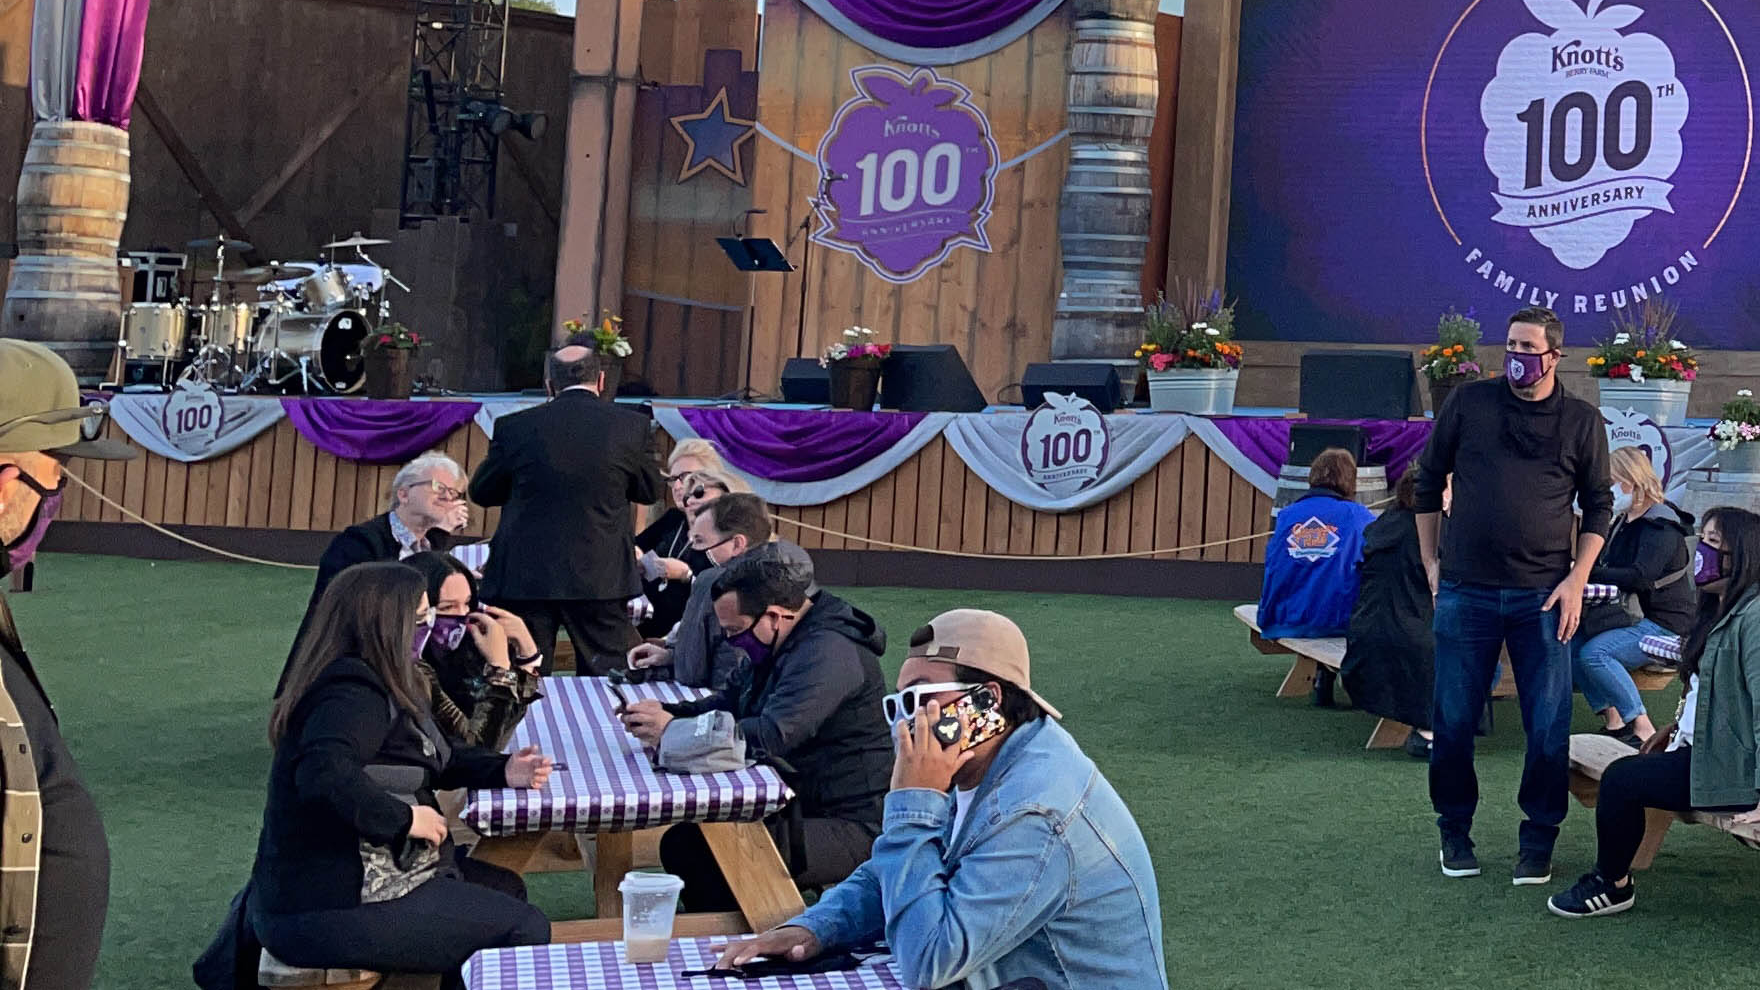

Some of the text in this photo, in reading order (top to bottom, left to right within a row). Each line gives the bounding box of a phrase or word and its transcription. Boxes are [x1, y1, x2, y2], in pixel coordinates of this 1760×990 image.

[1551, 39, 1625, 74] Knott's
[1526, 185, 1645, 218] ANNIVERSARY
[1464, 248, 1699, 313] FAMILY REUNION
[176, 404, 212, 434] 100
